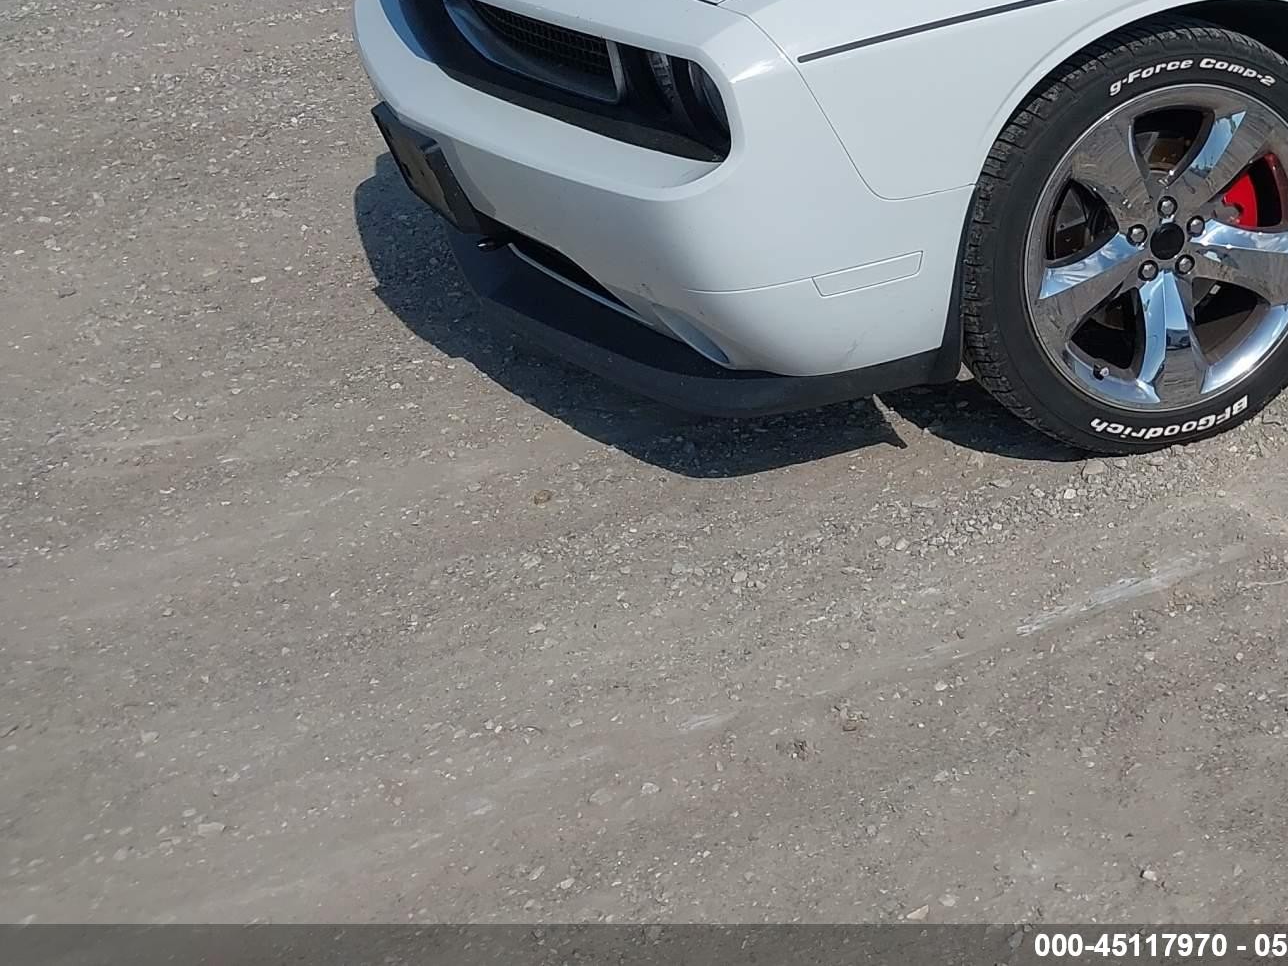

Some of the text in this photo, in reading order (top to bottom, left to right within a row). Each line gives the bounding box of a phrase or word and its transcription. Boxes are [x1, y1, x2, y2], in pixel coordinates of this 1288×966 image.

[1109, 57, 1277, 96] g-Force Comp-2
[1090, 394, 1249, 440] BFGoodrich
